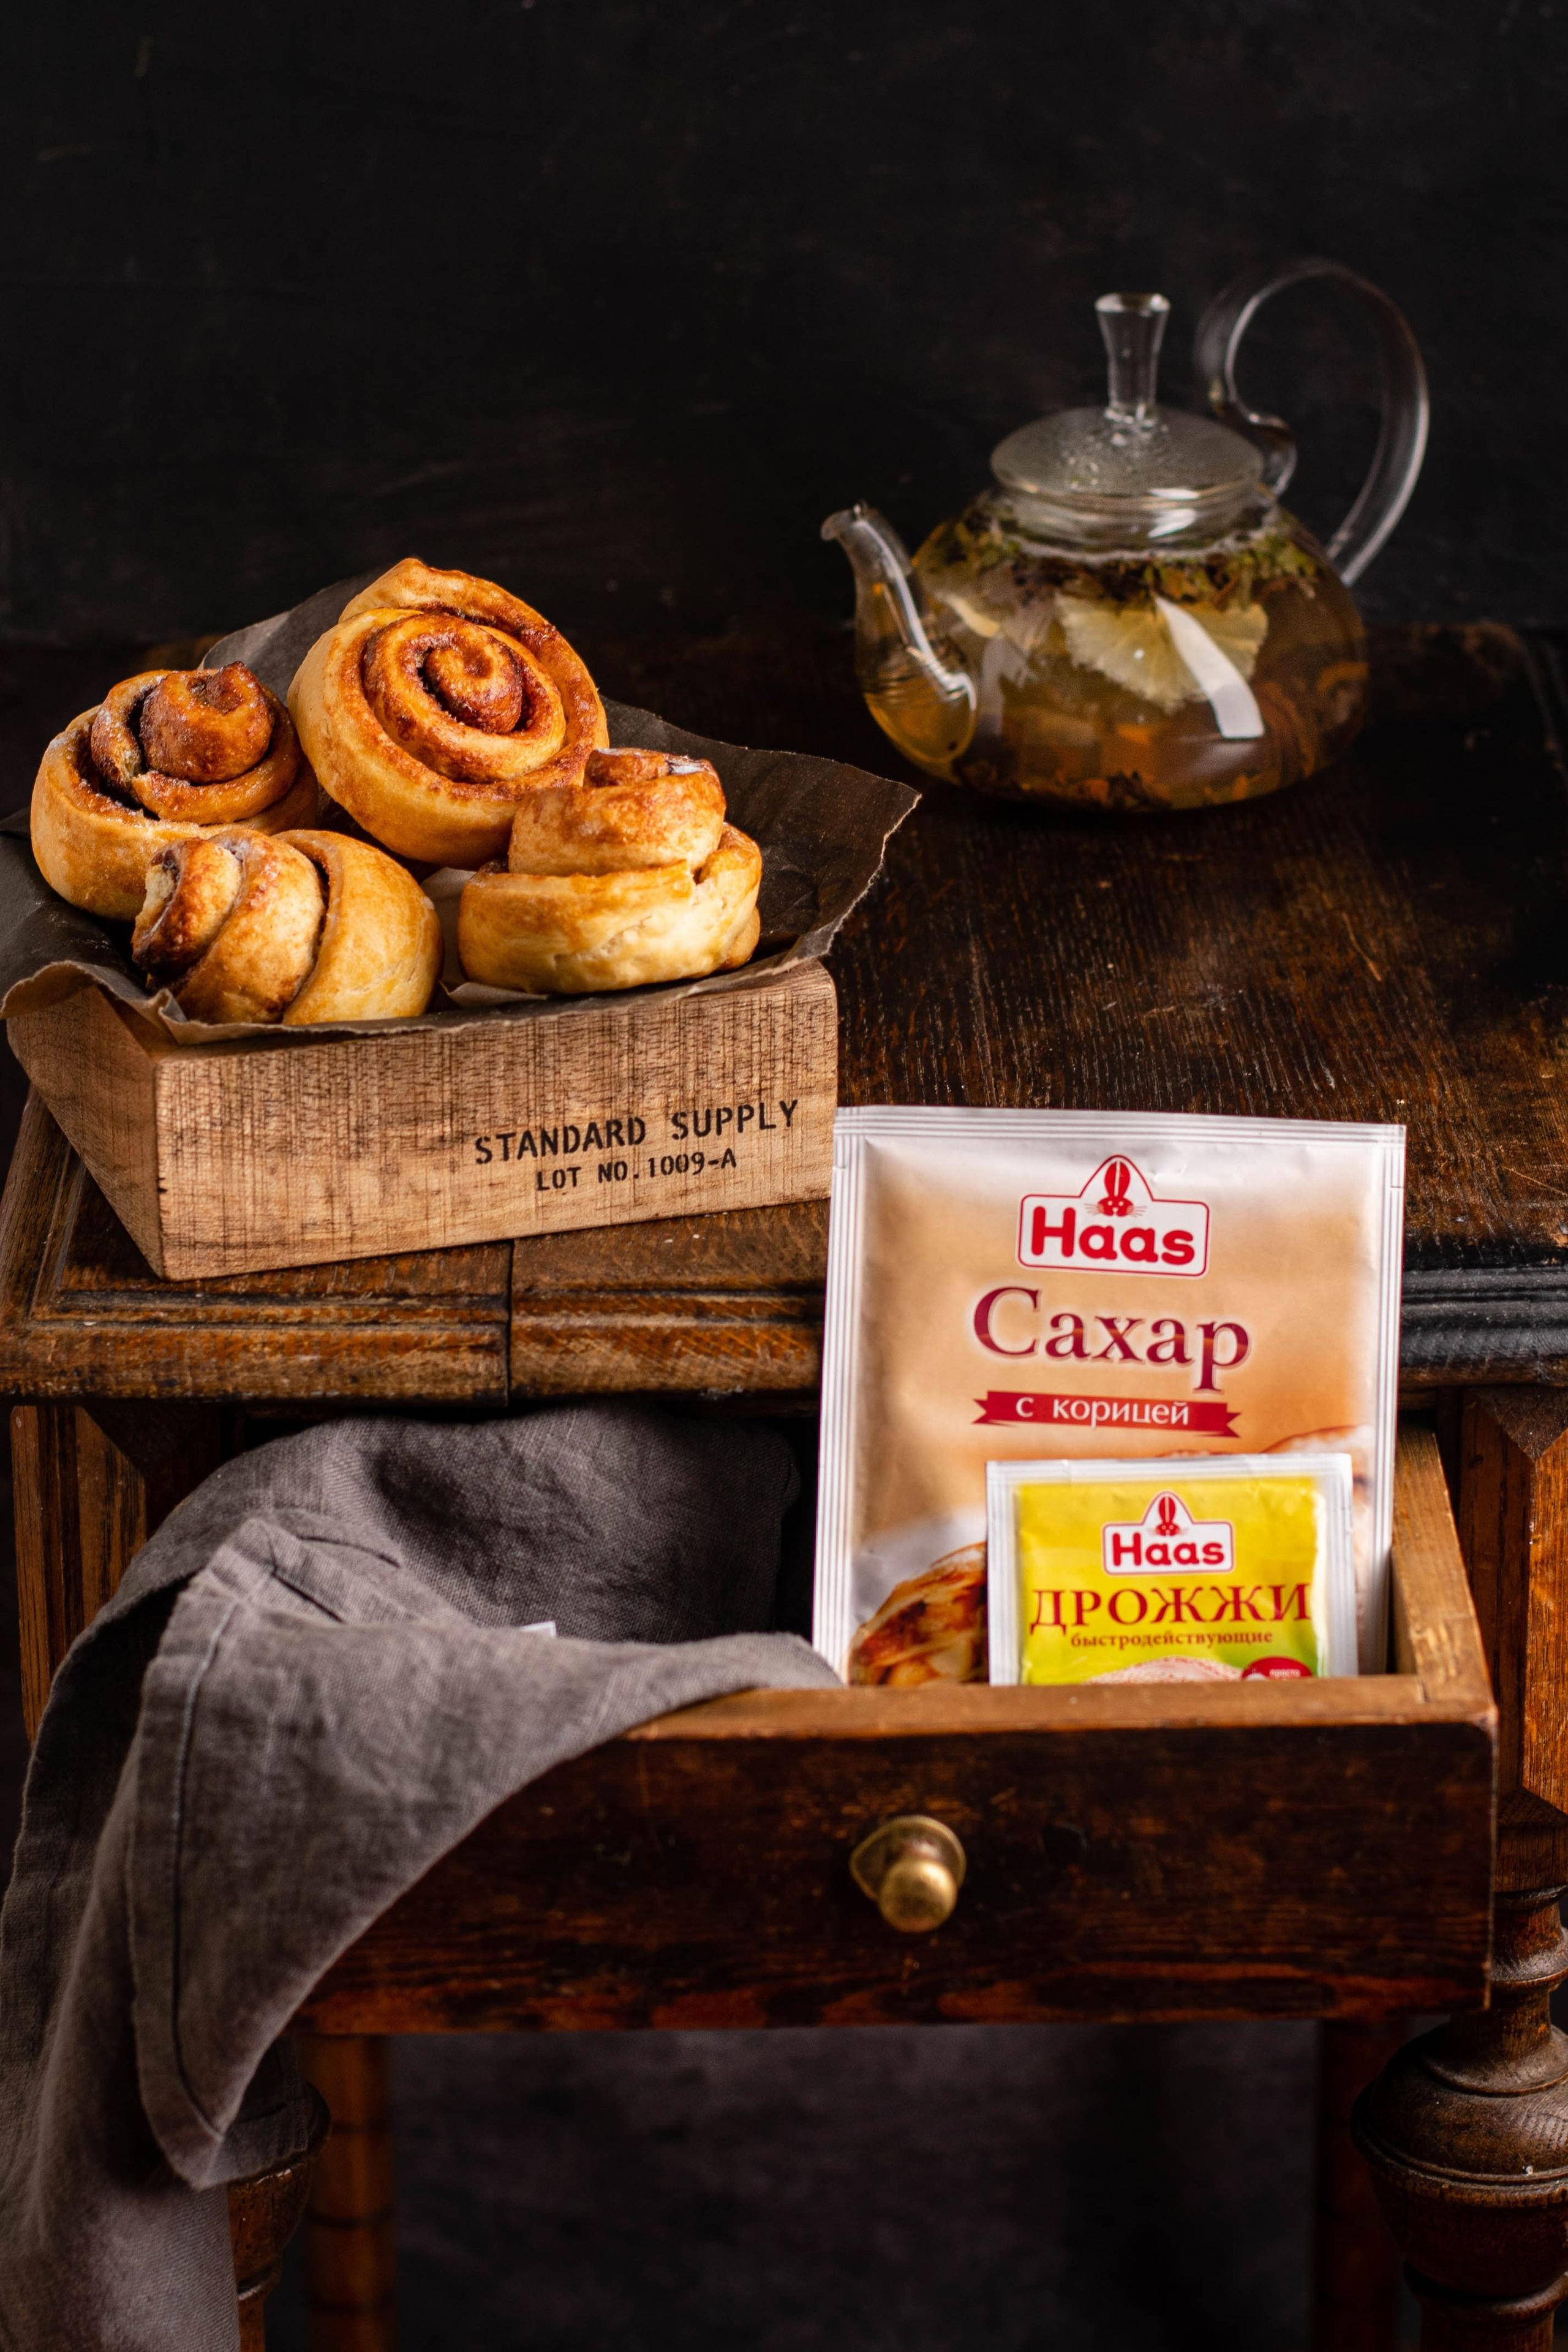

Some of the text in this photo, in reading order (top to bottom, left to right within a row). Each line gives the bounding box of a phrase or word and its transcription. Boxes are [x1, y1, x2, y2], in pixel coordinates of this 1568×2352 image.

[475, 1099, 798, 1164] STANDARD SUPPLY
[537, 1166, 582, 1191] LOT
[1031, 1205, 1196, 1266] Haas
[973, 1286, 1250, 1393] Сахар
[1016, 1396, 1189, 1430] с корицей
[1112, 1532, 1225, 1567] Haas
[1030, 1583, 1311, 1635] ДРОЖЖИ
[1070, 1630, 1274, 1650] быстродействующие
